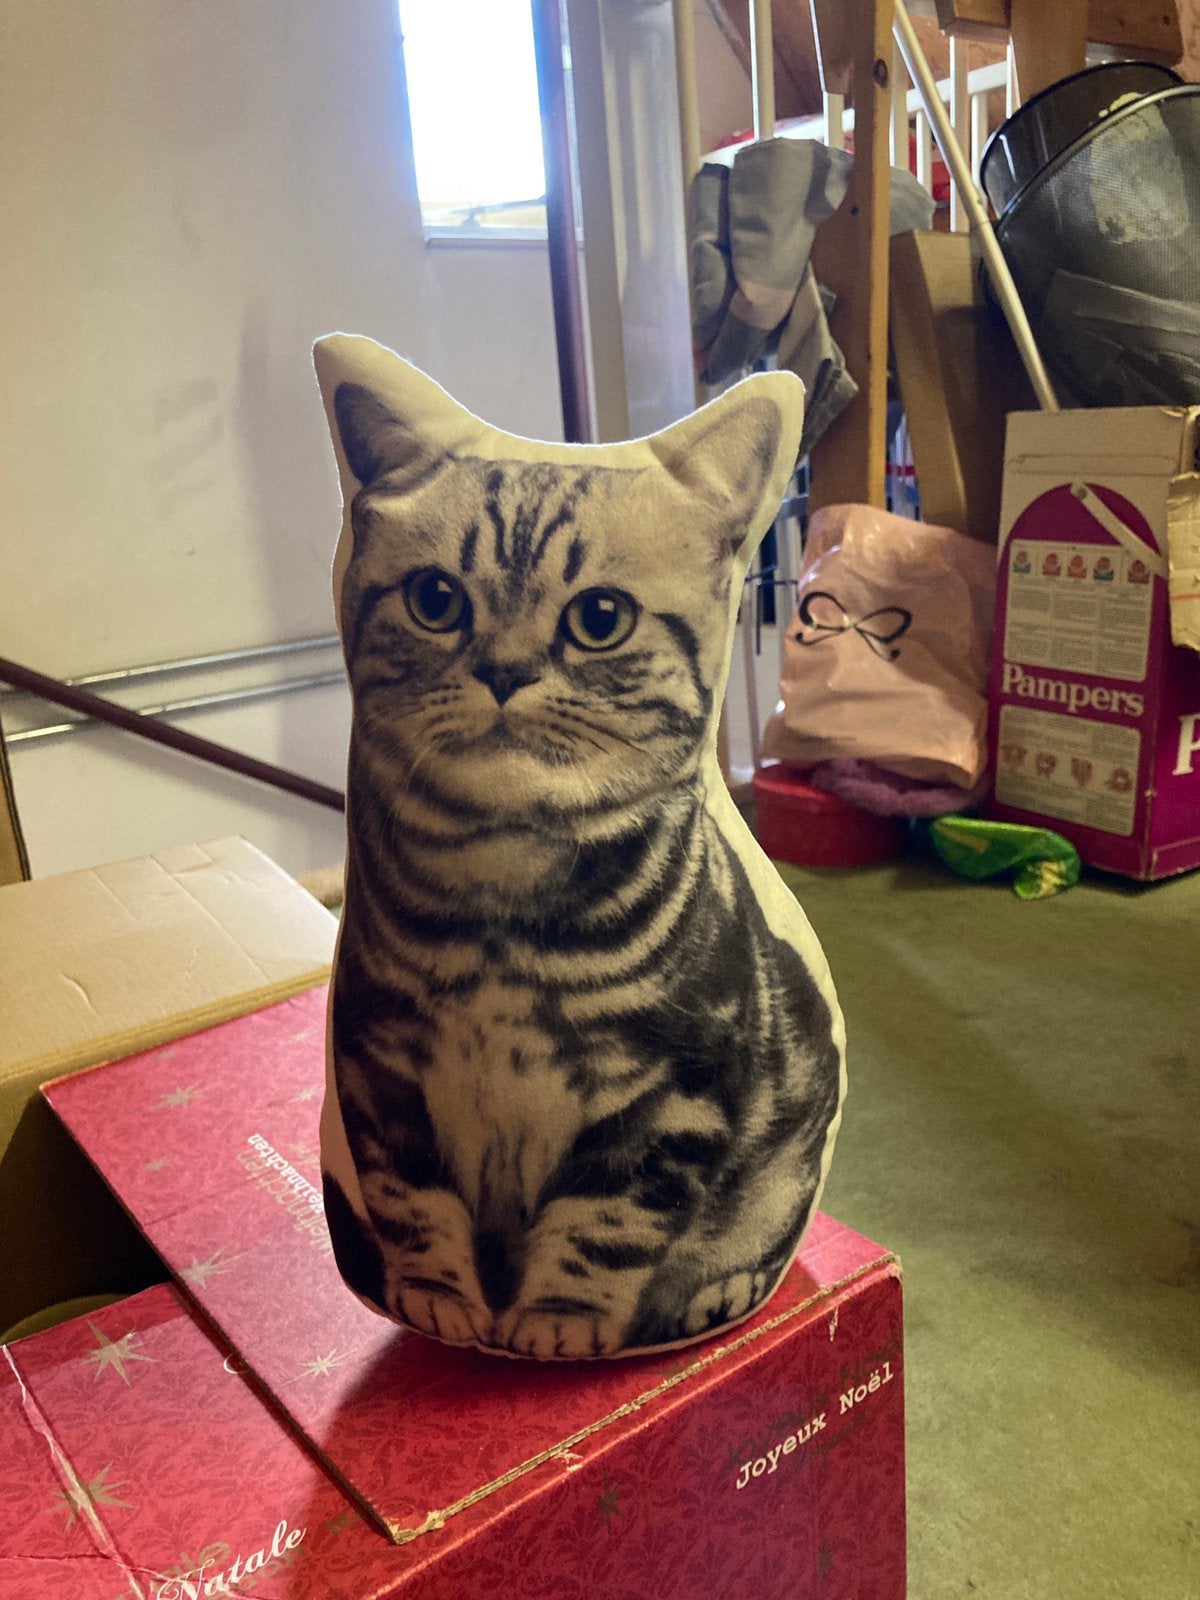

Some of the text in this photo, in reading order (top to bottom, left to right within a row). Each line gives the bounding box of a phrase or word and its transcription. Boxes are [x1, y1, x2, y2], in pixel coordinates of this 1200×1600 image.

[1002, 663, 1144, 717] Pampers
[735, 1412, 828, 1490] Joyeux
[839, 1361, 894, 1415] Noël
[156, 1520, 307, 1600] Natale
